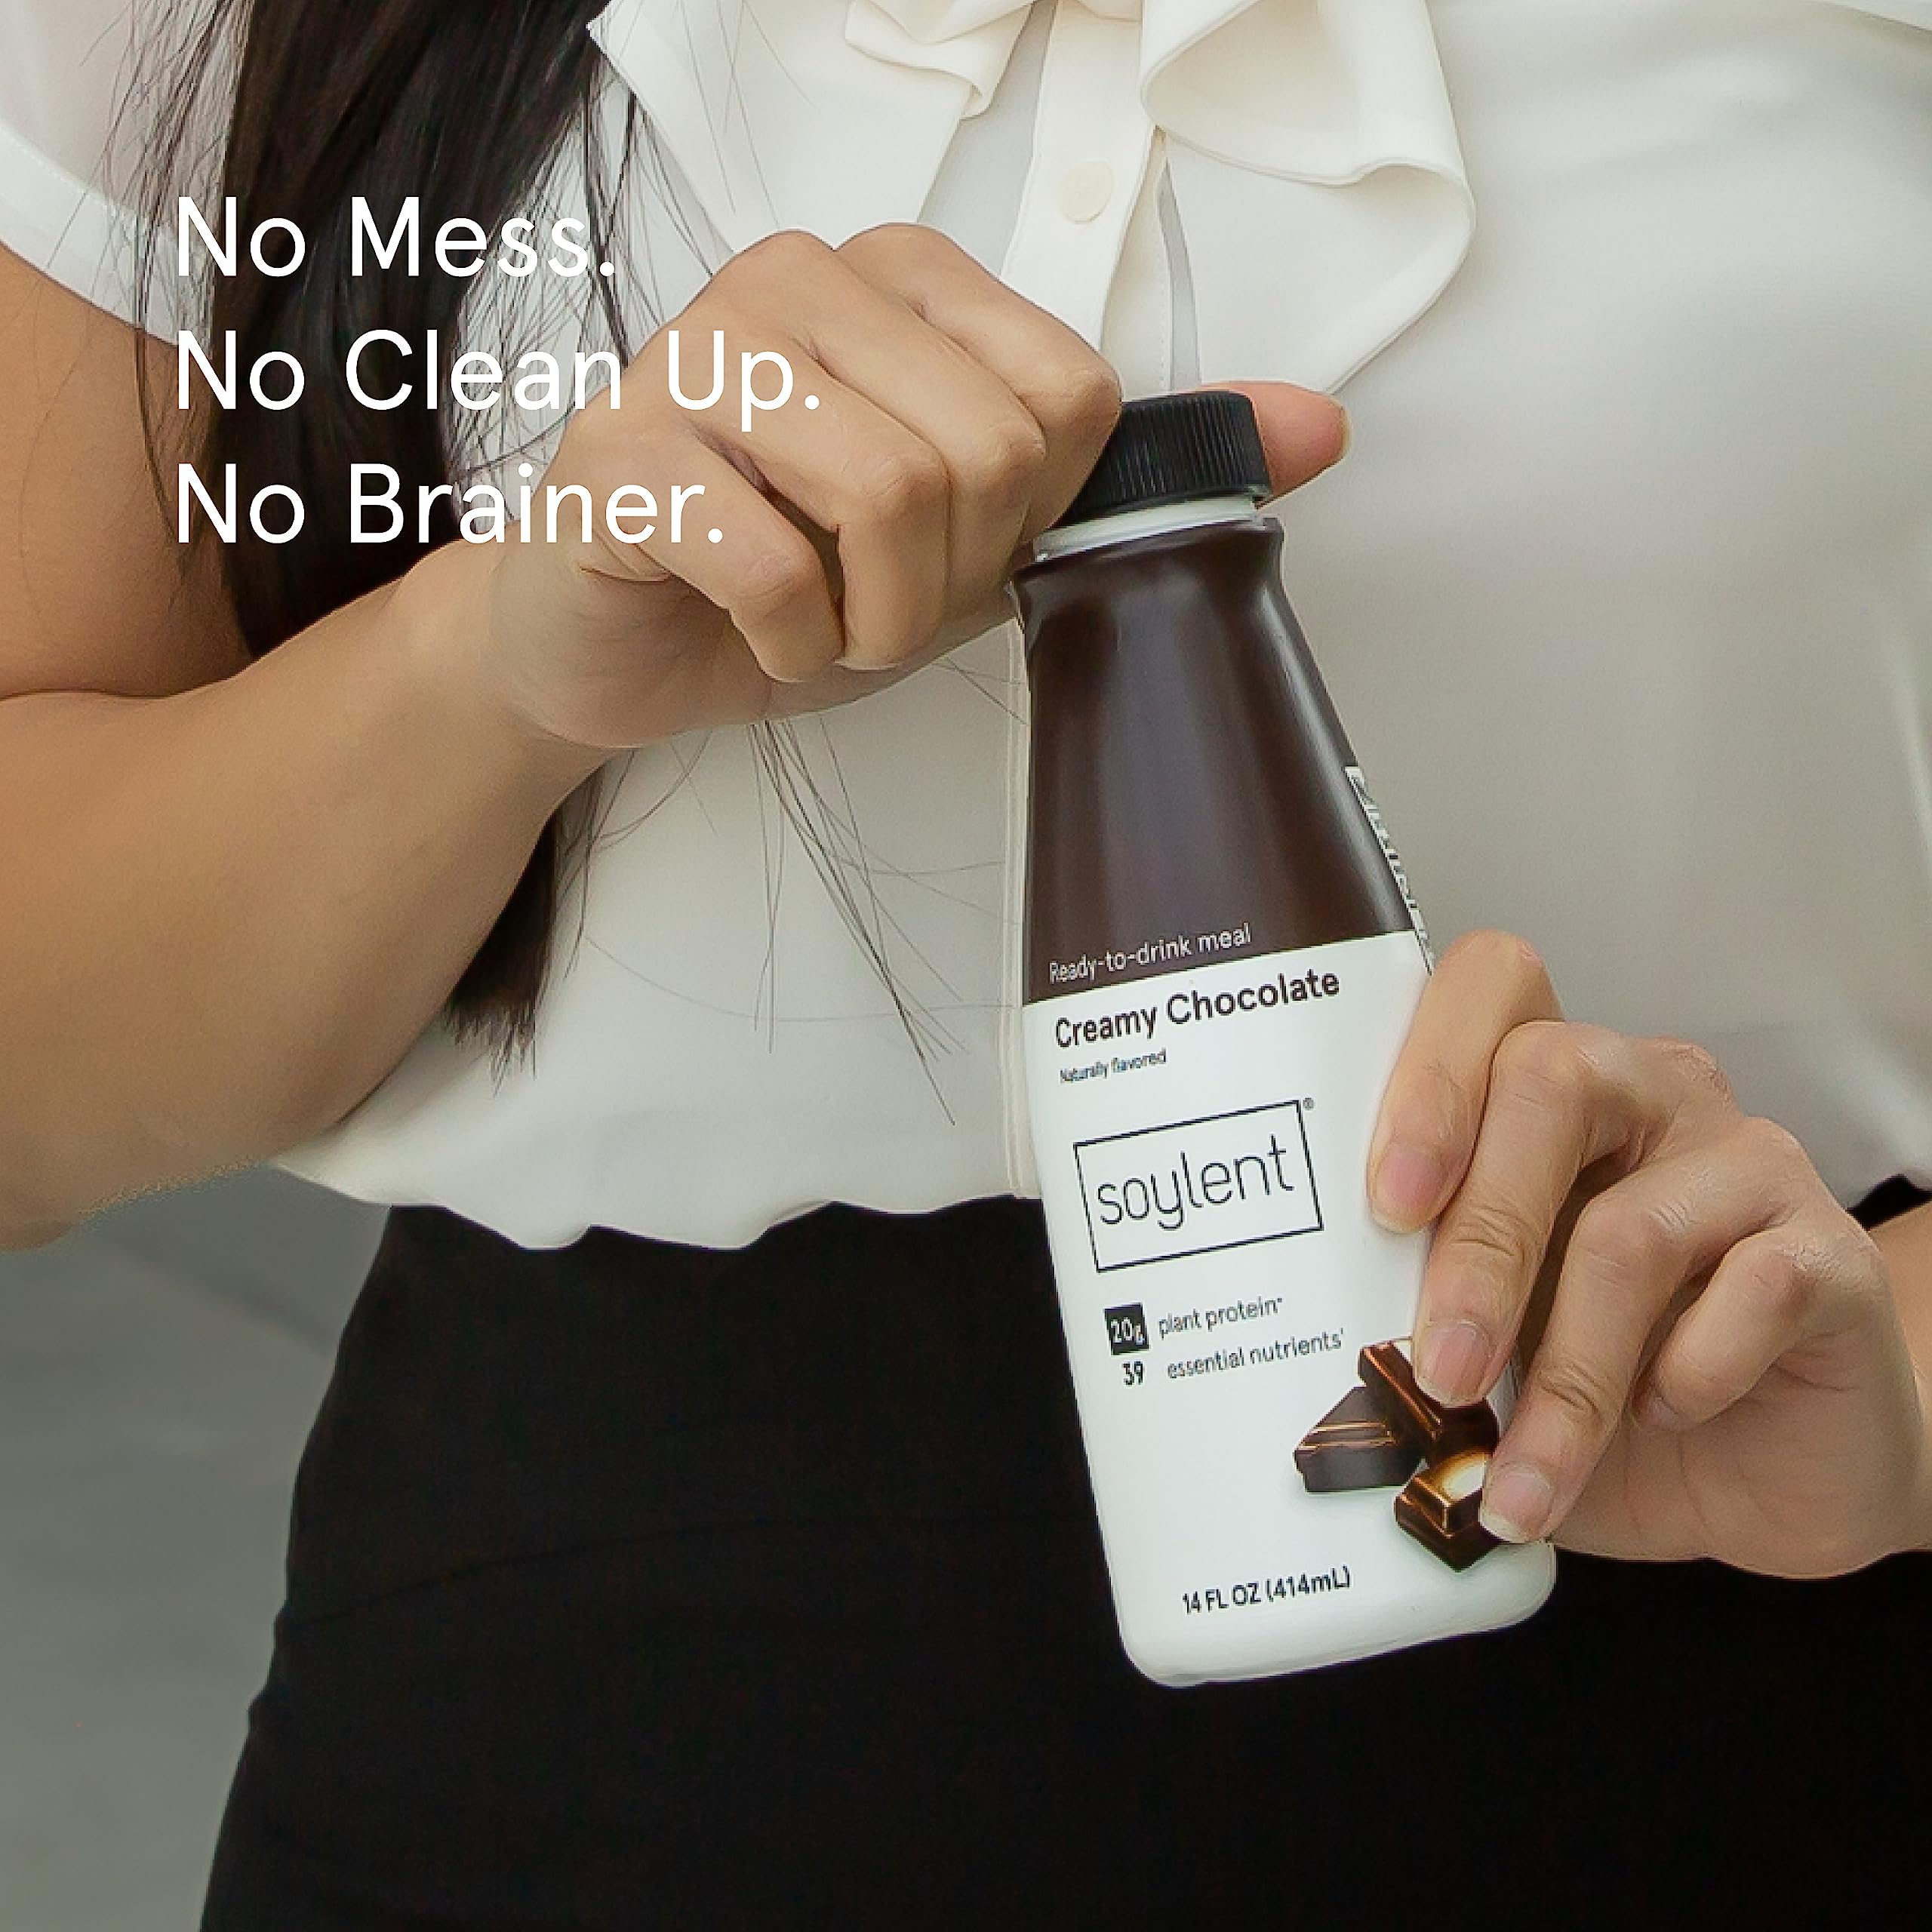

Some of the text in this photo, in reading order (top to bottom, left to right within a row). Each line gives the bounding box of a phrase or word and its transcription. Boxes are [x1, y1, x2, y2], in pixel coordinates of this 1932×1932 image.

[1049, 921, 1251, 984] Ready-to-drink meal
[1056, 969, 1340, 1048] Creamy Chocolate
[1111, 1048, 1167, 1073] flavored
[1097, 1134, 1295, 1232] soylent
[1158, 1308, 1201, 1340] plant
[1121, 1361, 1144, 1386] 39
[1168, 1346, 1244, 1379] essential
[1182, 1564, 1351, 1614] 14 FL OZ (414mL)
